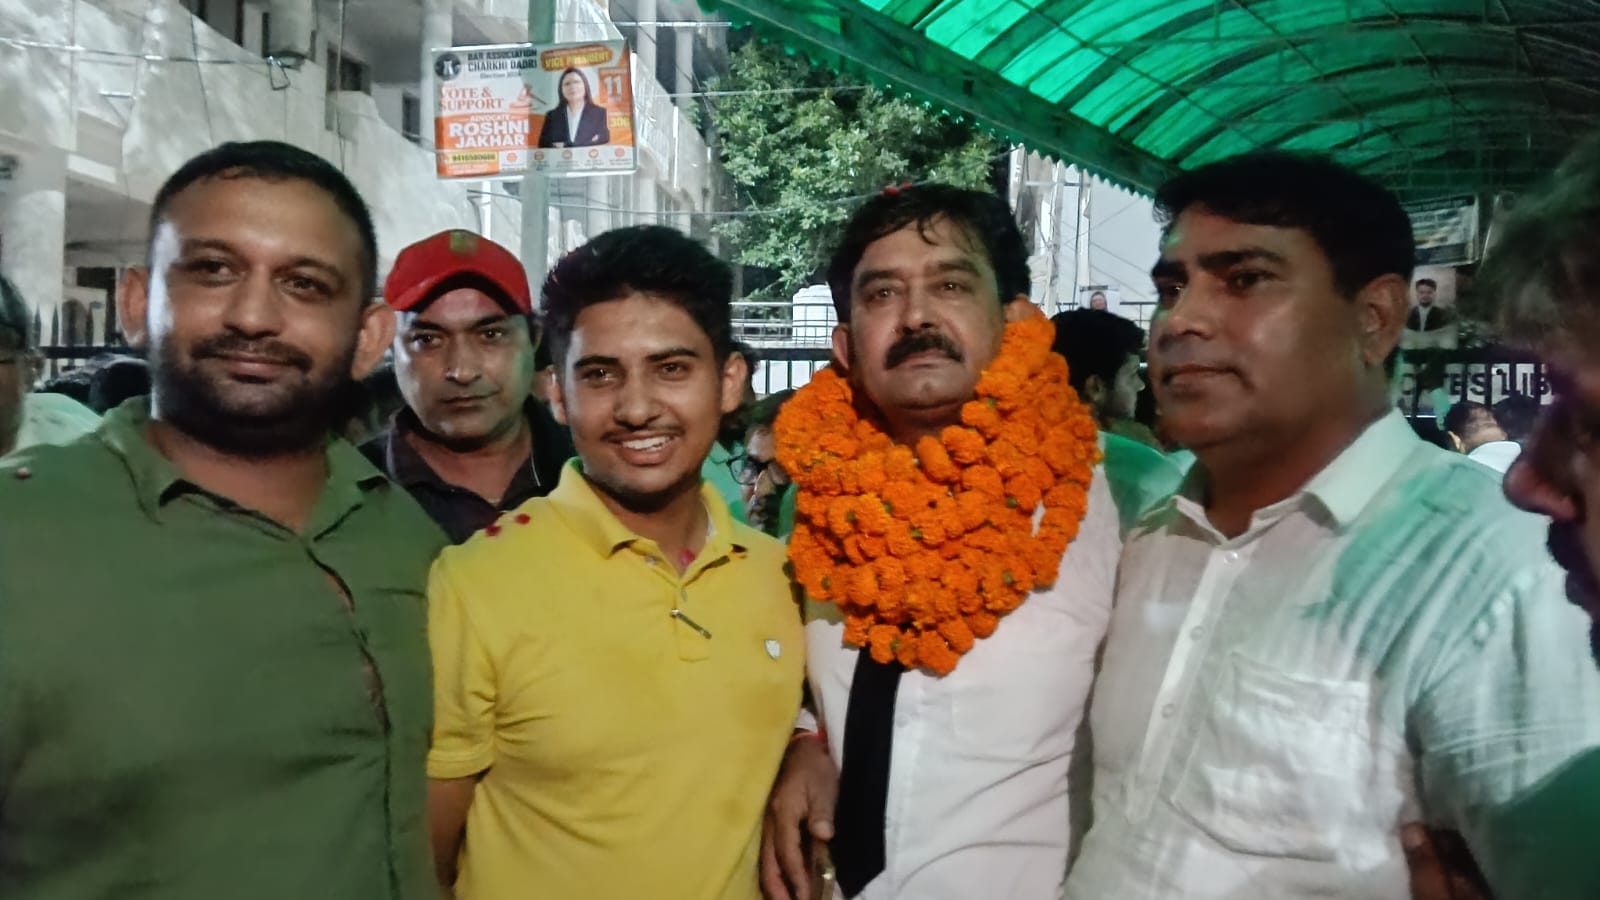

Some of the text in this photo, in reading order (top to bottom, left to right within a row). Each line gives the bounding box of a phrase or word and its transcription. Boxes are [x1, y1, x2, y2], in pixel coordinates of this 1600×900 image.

[468, 58, 538, 72] CHARKHI DADRI
[604, 75, 622, 98] 11
[438, 97, 504, 112] SUPPORT
[449, 119, 529, 137] ROSHNI
[455, 133, 525, 149] JAKHAR
